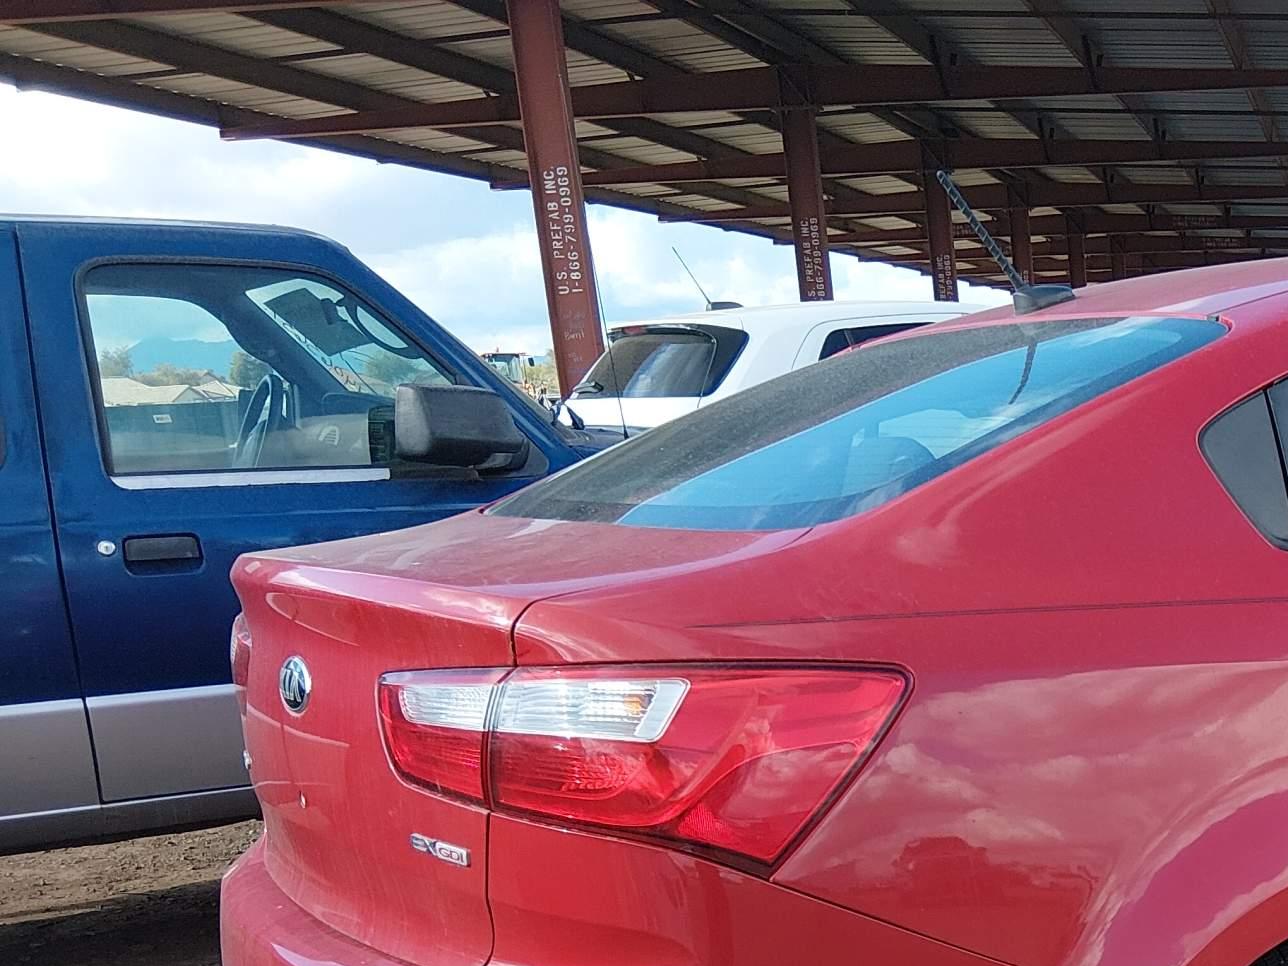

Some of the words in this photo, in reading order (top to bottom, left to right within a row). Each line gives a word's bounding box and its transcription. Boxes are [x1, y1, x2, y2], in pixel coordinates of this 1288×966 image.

[543, 166, 557, 194] INC.
[547, 201, 564, 259] PREFAB
[556, 166, 584, 293] 1-866-799-0969
[803, 242, 815, 282] PREFAB
